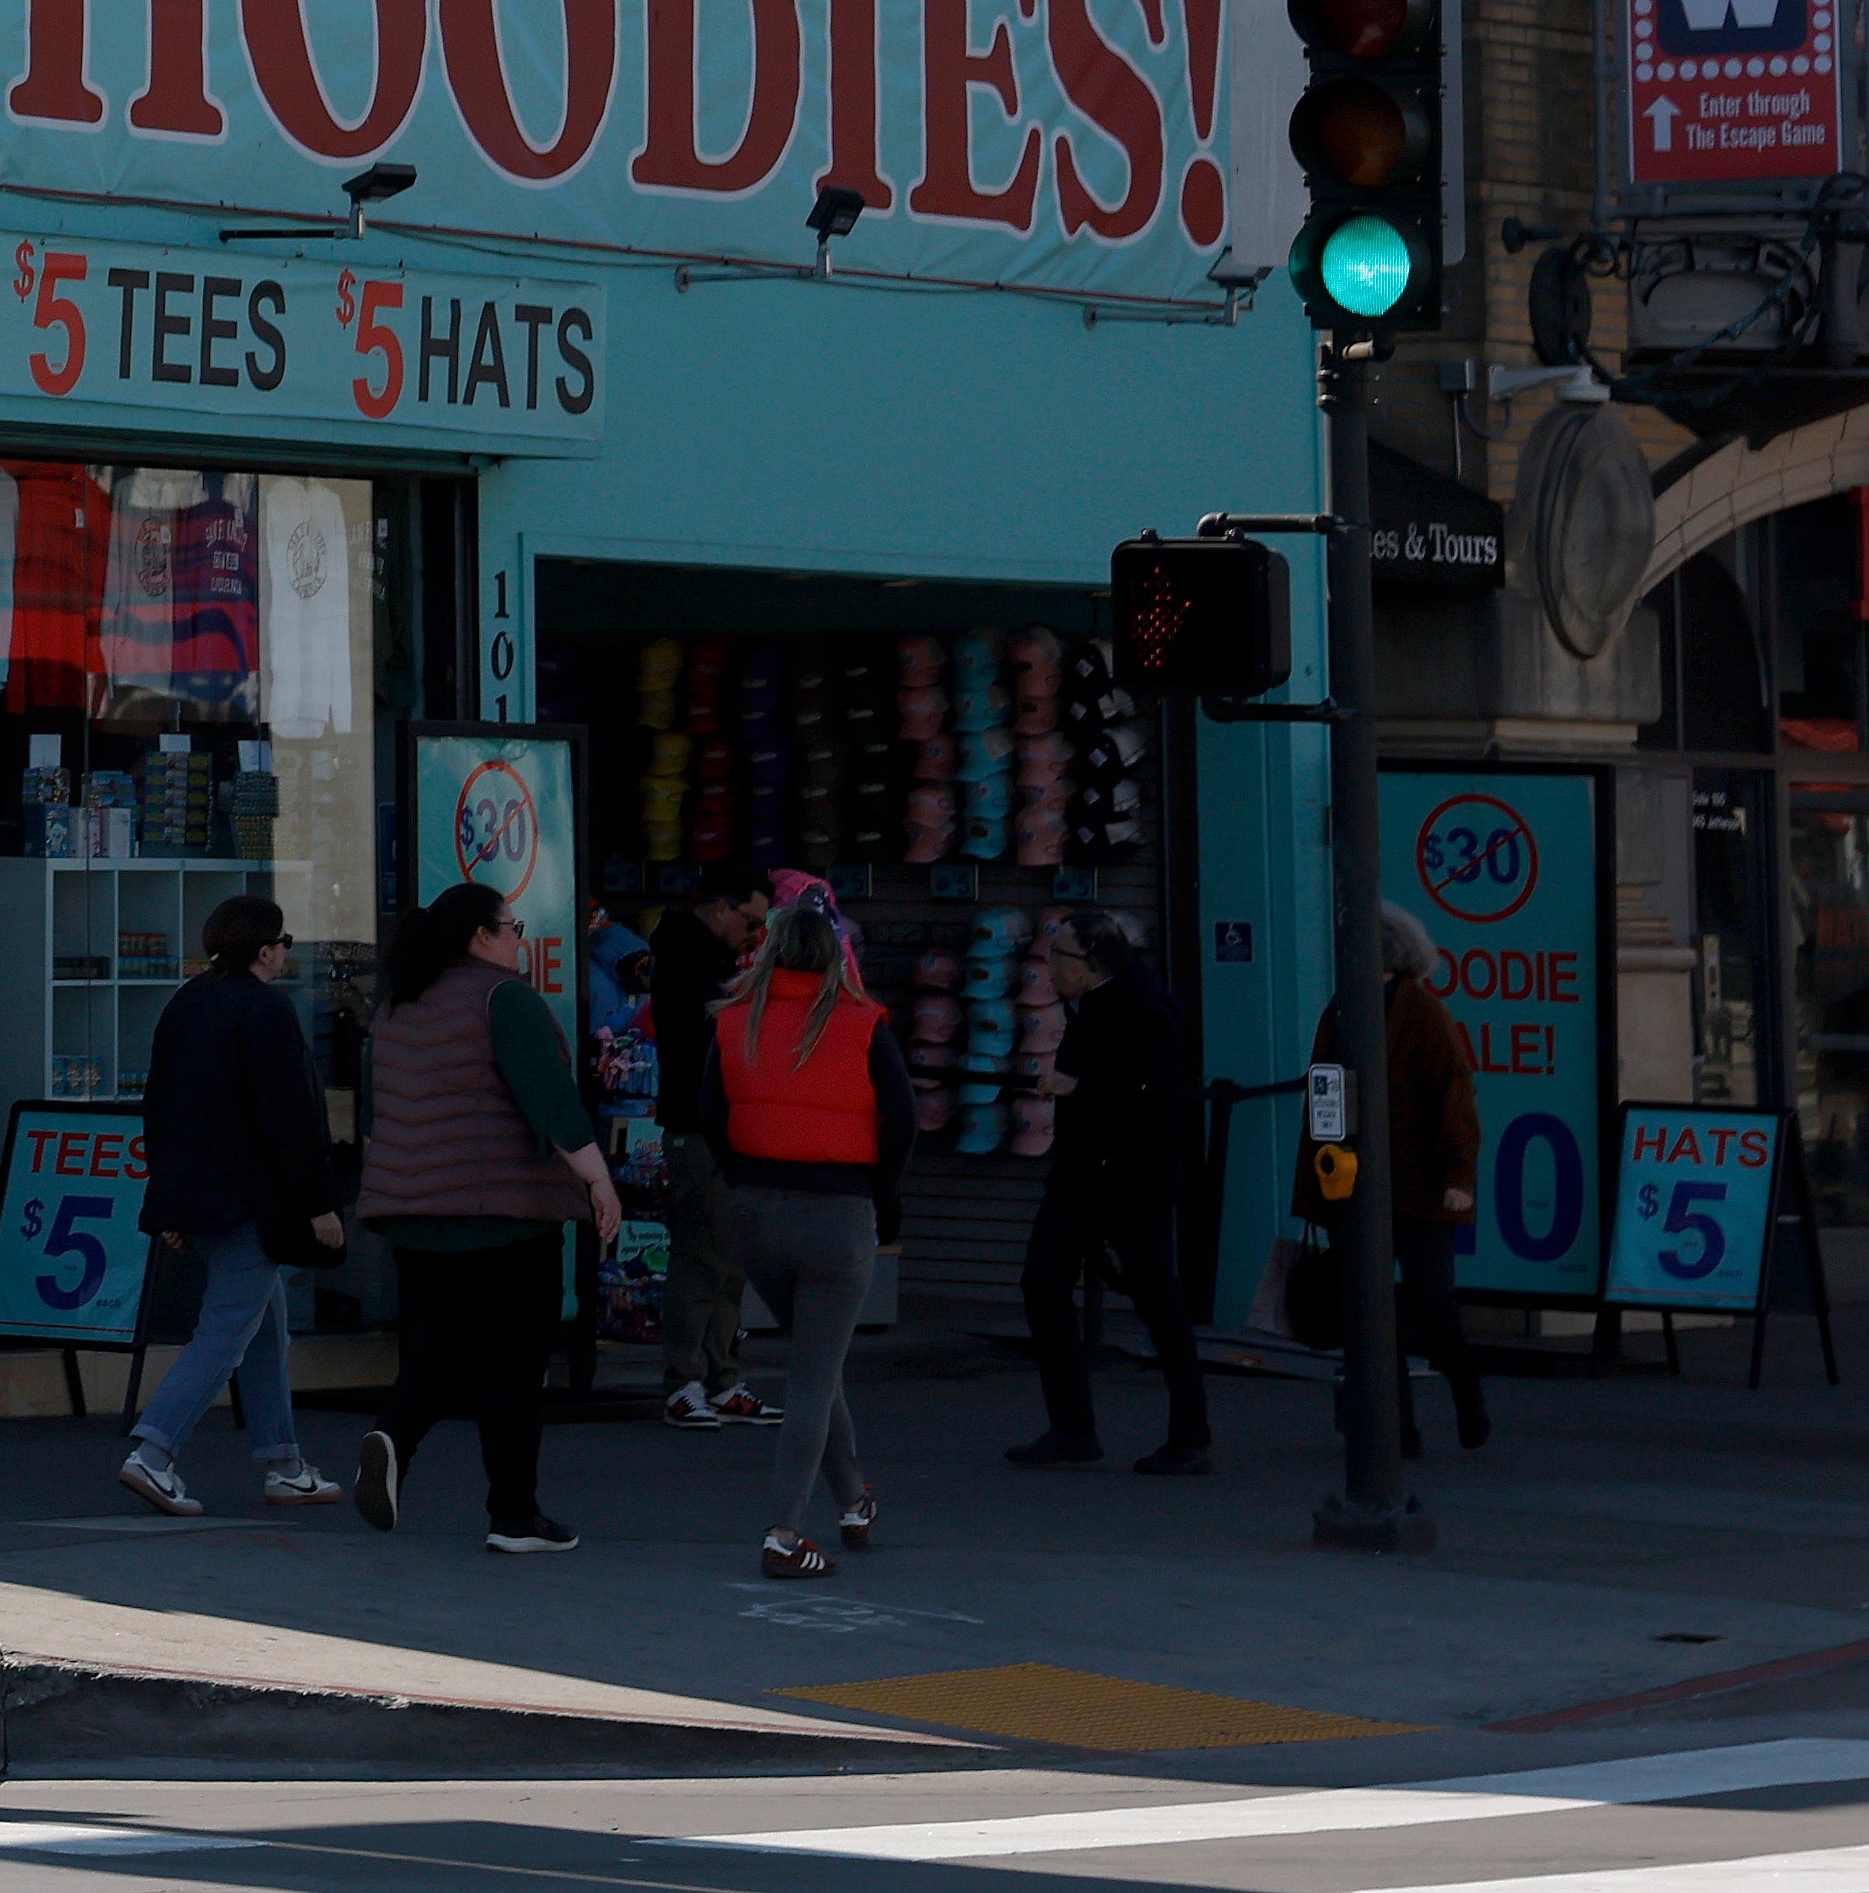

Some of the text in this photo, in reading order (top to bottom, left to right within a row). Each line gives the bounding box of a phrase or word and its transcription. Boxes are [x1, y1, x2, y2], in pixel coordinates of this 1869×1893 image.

[1700, 87, 1811, 122] Enter through
[1685, 119, 1827, 153] The Escape Game
[12, 239, 88, 396] $5
[107, 266, 287, 392] TEES
[335, 267, 404, 420] $5
[418, 295, 595, 416] HATS
[1405, 523, 1499, 566] & Tours
[461, 797, 526, 863] $30
[1424, 827, 1520, 885] $30
[1425, 948, 1579, 1003] OODIE
[27, 1129, 152, 1180] TEES
[1633, 1126, 1769, 1168] HATS
[20, 1195, 107, 1311] $5
[1638, 1181, 1728, 1280] $5
